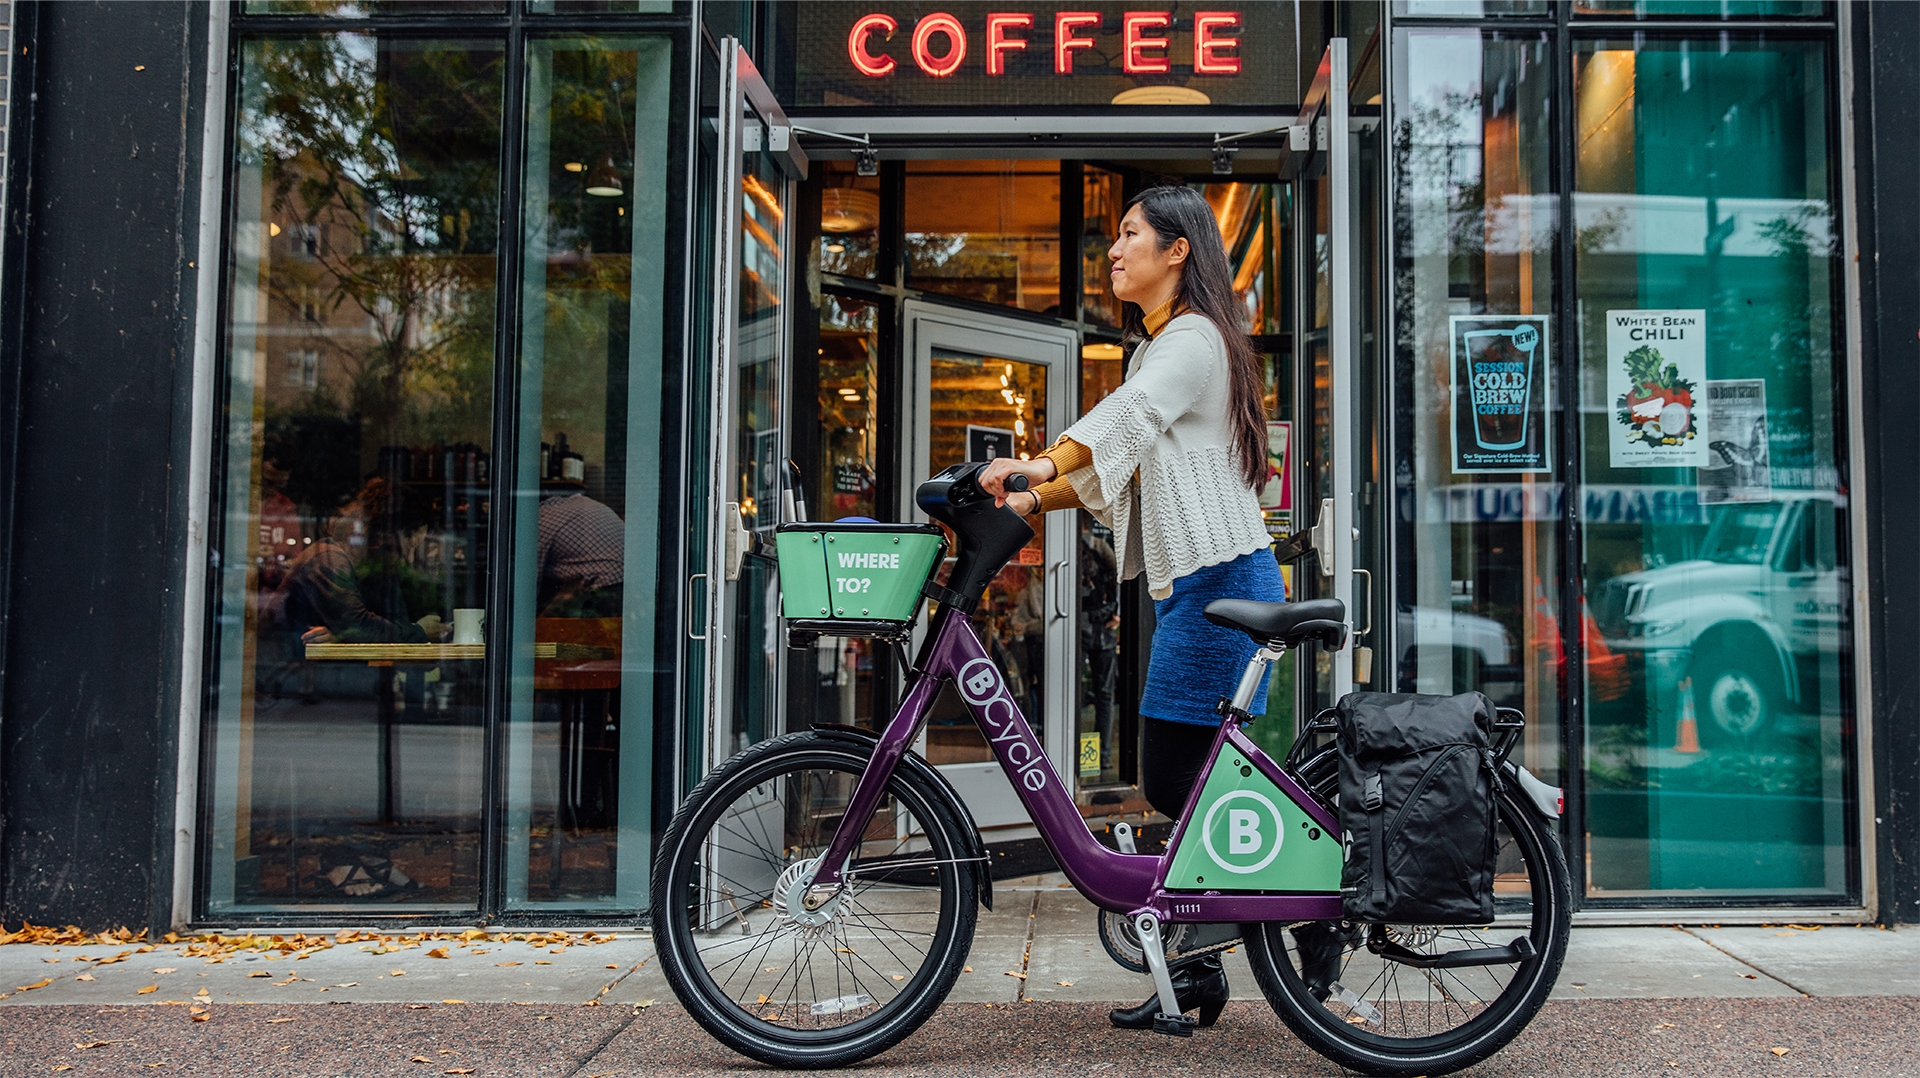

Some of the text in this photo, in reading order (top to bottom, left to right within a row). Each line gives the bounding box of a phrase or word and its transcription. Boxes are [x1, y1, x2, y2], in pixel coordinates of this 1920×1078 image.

[849, 12, 1241, 77] COFFEE
[1616, 316, 1696, 326] WHITE BEAN
[1514, 330, 1536, 346] NEW!
[1630, 328, 1684, 341] CHILI
[1474, 362, 1525, 373] SESSION
[1473, 372, 1527, 390] COLD
[1475, 389, 1526, 404] BREW
[1478, 404, 1522, 415] COFFEE
[837, 552, 900, 569] WHERE
[836, 577, 872, 594] TO?
[1228, 809, 1265, 855] B
[1174, 903, 1201, 914] 11111
